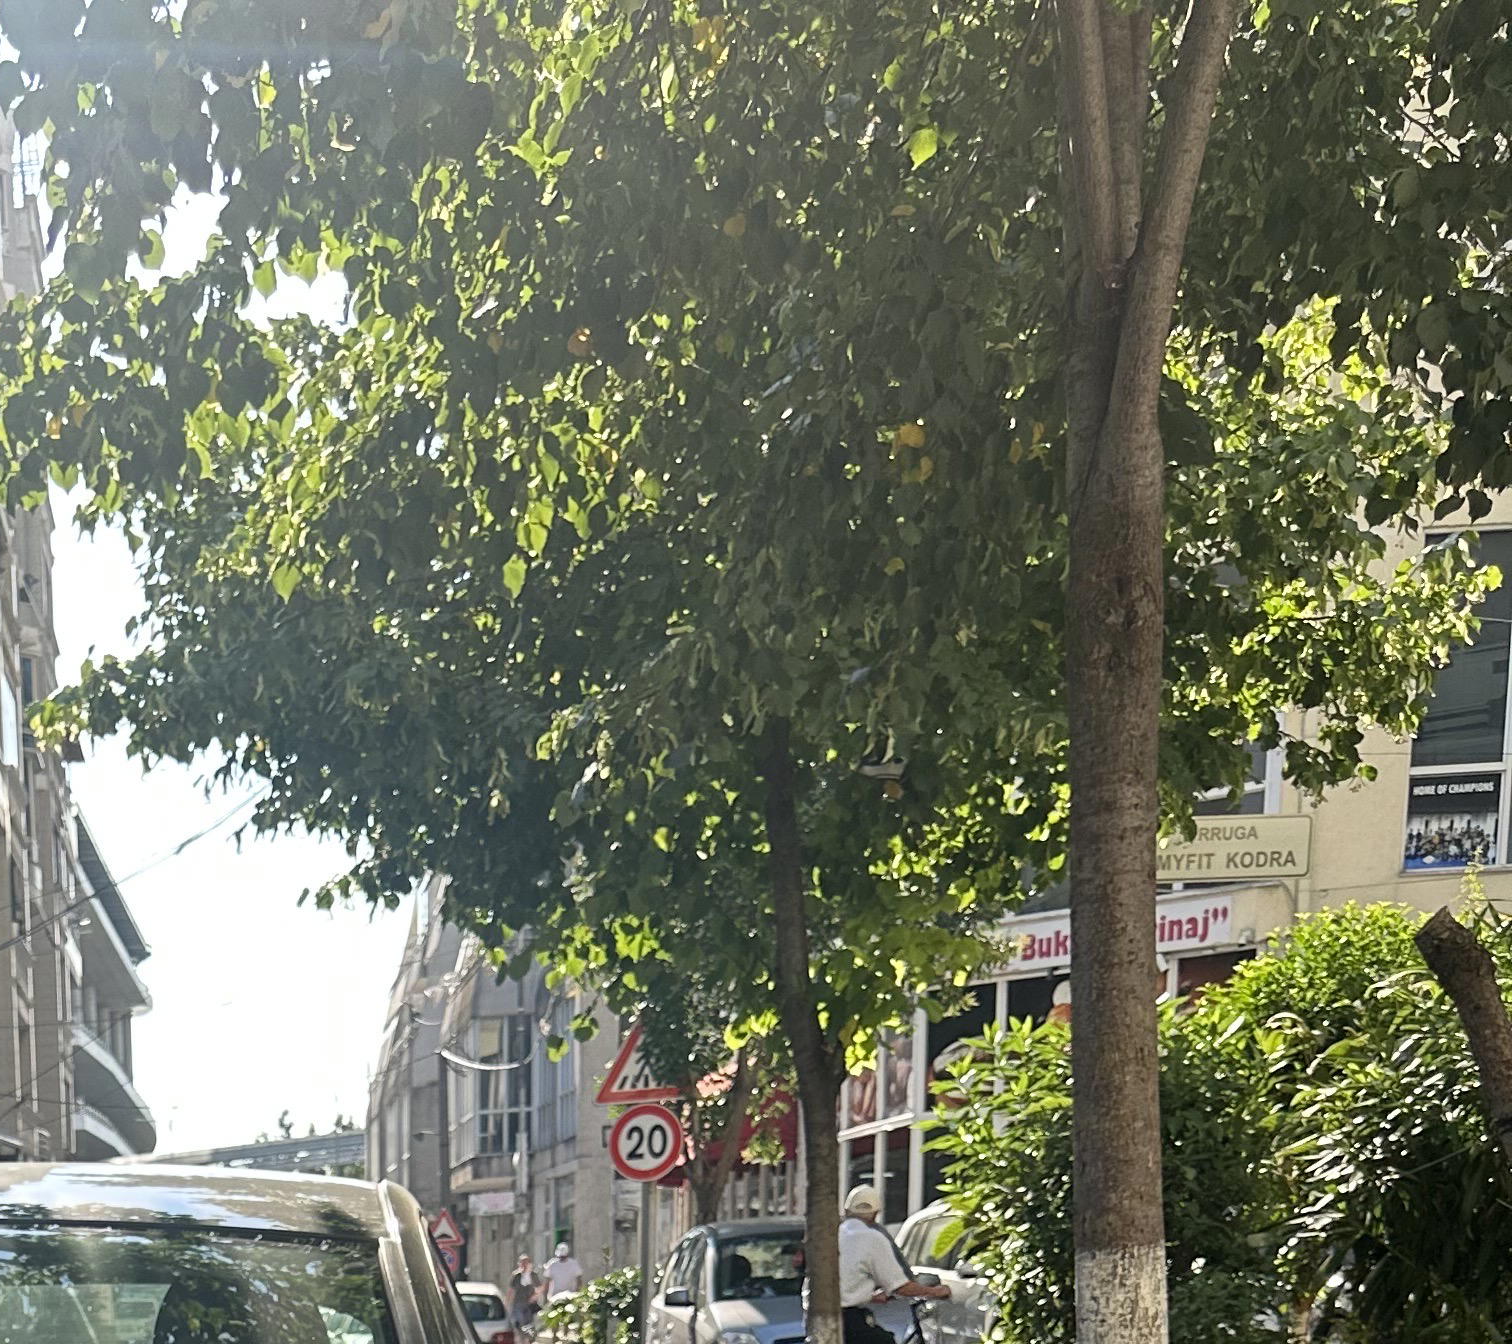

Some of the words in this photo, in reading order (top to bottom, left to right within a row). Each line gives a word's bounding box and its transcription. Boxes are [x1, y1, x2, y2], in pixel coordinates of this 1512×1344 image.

[1413, 785, 1435, 796] HOME
[1436, 784, 1448, 795] OF
[1448, 782, 1495, 794] CHAMPIONS
[1198, 826, 1259, 841] RRUGA
[1157, 853, 1216, 871] MYFIT
[1226, 850, 1297, 869] KODRA
[626, 1124, 667, 1160] 20
